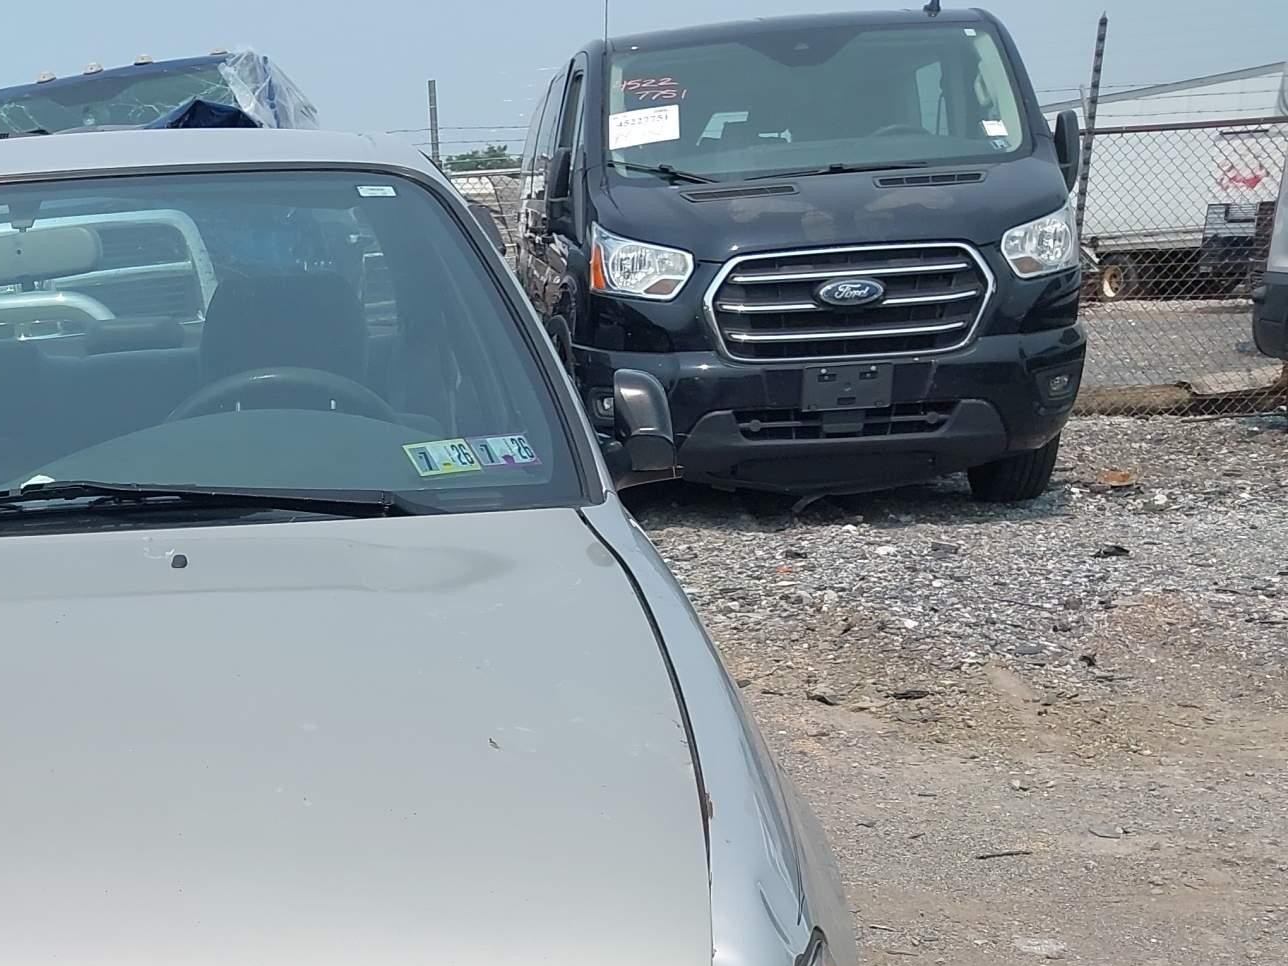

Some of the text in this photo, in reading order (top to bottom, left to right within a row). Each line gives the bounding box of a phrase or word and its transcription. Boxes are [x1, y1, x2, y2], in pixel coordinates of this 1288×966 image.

[834, 283, 871, 299] Ford
[451, 443, 475, 465] 26
[510, 437, 534, 459] 26
